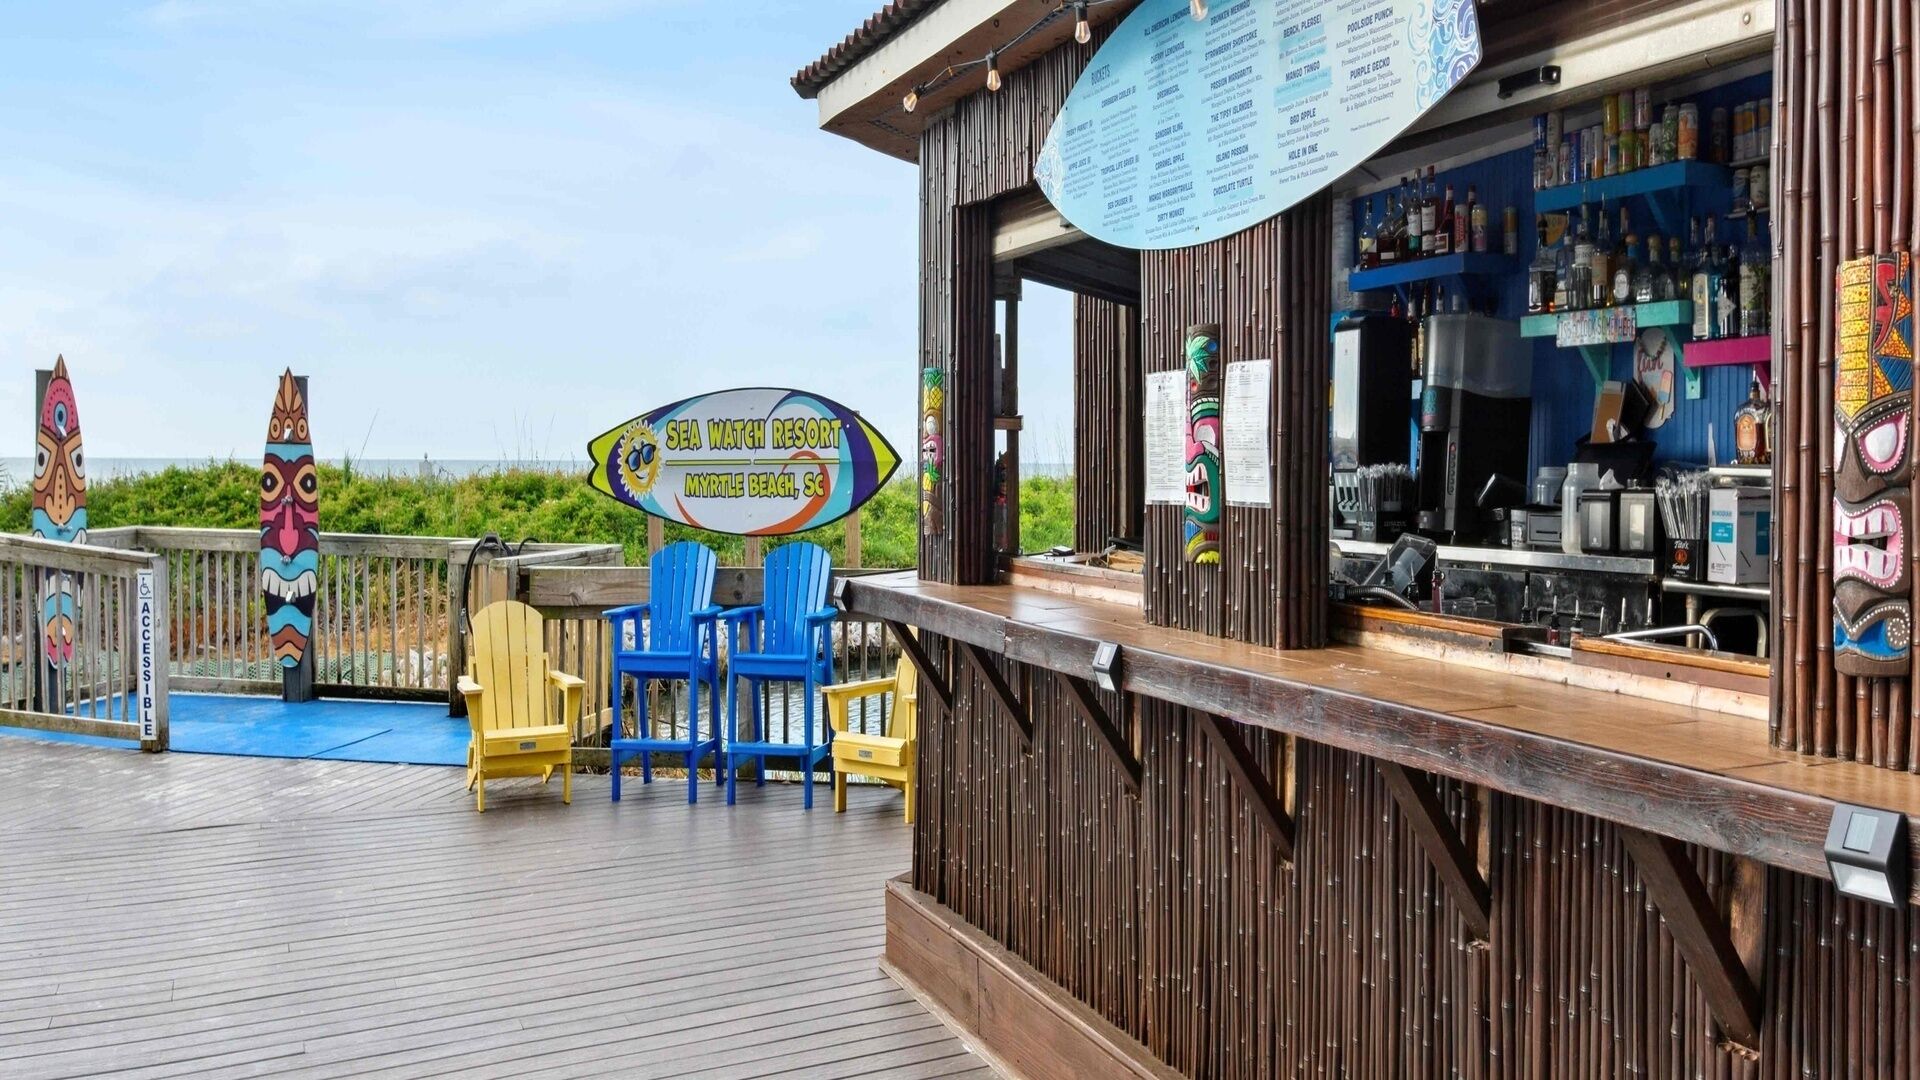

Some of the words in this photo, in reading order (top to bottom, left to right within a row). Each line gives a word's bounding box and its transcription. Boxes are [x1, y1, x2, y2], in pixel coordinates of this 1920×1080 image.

[1348, 15, 1374, 34] POOLSIDE
[1374, 7, 1394, 24] PUNCH
[1164, 40, 1184, 57] LEMONADE
[1204, 42, 1232, 61] STRAWBERRY
[1232, 28, 1258, 48] SHORTCAKE
[1092, 64, 1110, 86] BUCKETS
[1210, 76, 1228, 91] PASSION
[1228, 66, 1252, 84] MARGARITA
[1286, 68, 1302, 82] MANGO
[1304, 61, 1320, 76] TANGO
[1350, 64, 1371, 80] PURPLE
[1372, 57, 1390, 72] GECKO
[1210, 112, 1220, 123] THE
[1220, 108, 1232, 120] TIPSY
[1232, 99, 1253, 115] ISLANDER
[1290, 114, 1300, 126] BAD
[1300, 108, 1316, 122] APPLE
[1172, 152, 1184, 164] APPLE
[1216, 150, 1230, 163] ISLAND
[1231, 144, 1248, 158] PASSION
[1288, 149, 1302, 160] HOLE
[1302, 146, 1307, 156] IN
[1308, 143, 1318, 154] ONE
[1213, 182, 1236, 196] CHOCOLATE
[1236, 176, 1252, 190] TURTLE
[1158, 212, 1168, 222] DIRTY
[1168, 207, 1184, 218] MONKEY
[666, 420, 701, 450] SEA
[707, 418, 766, 450] WATCH
[772, 418, 842, 450] RESORT
[684, 472, 744, 498] MYRTLE
[748, 472, 800, 500] BEACH,
[804, 472, 825, 498] SC
[141, 602, 152, 736] ACCESSIBLE
